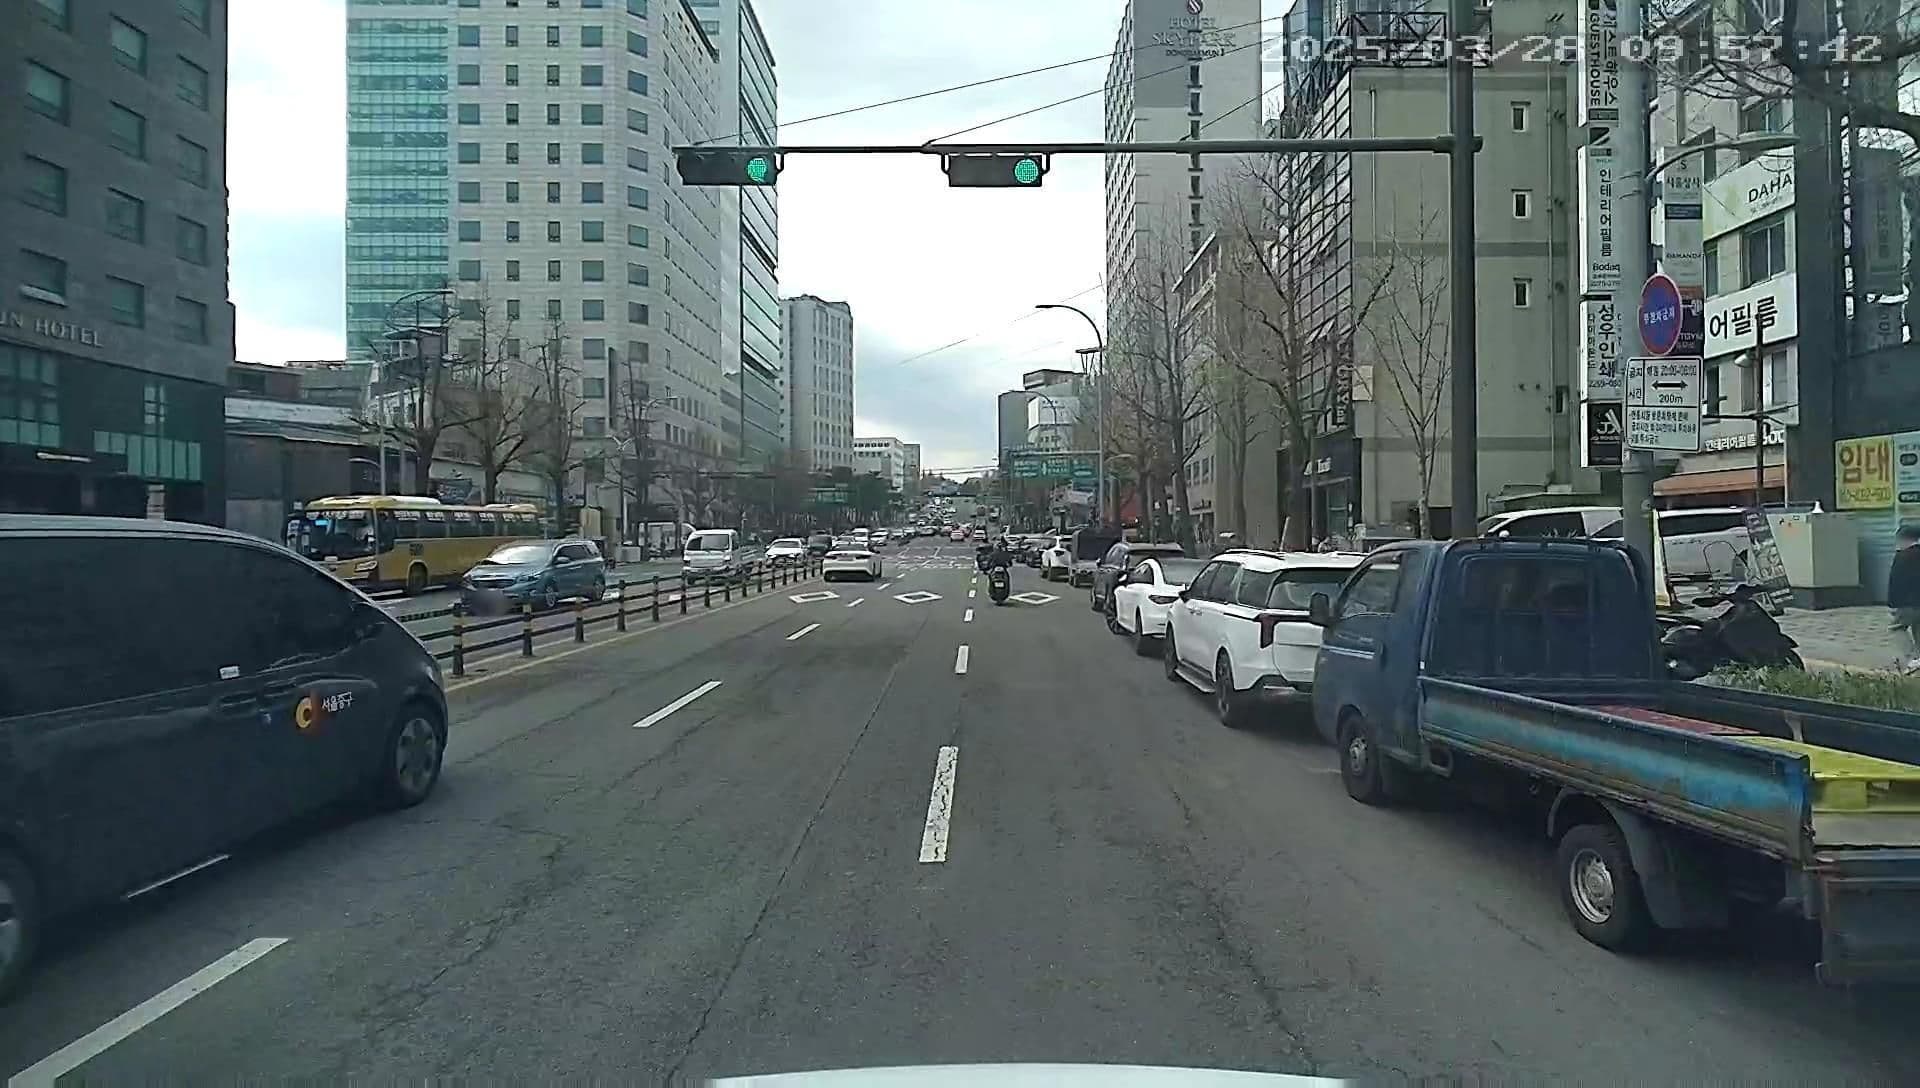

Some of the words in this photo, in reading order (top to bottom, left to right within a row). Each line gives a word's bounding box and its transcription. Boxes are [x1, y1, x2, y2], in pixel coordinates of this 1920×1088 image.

[1748, 173, 1793, 203] DAHA
[1599, 167, 1613, 257] 인테리어필름
[35, 319, 105, 348] HOTEL
[1709, 295, 1778, 340] 어필름
[1598, 303, 1616, 378] 성우인쇄
[1658, 393, 1684, 404] 200m
[1839, 442, 1890, 484] 임대
